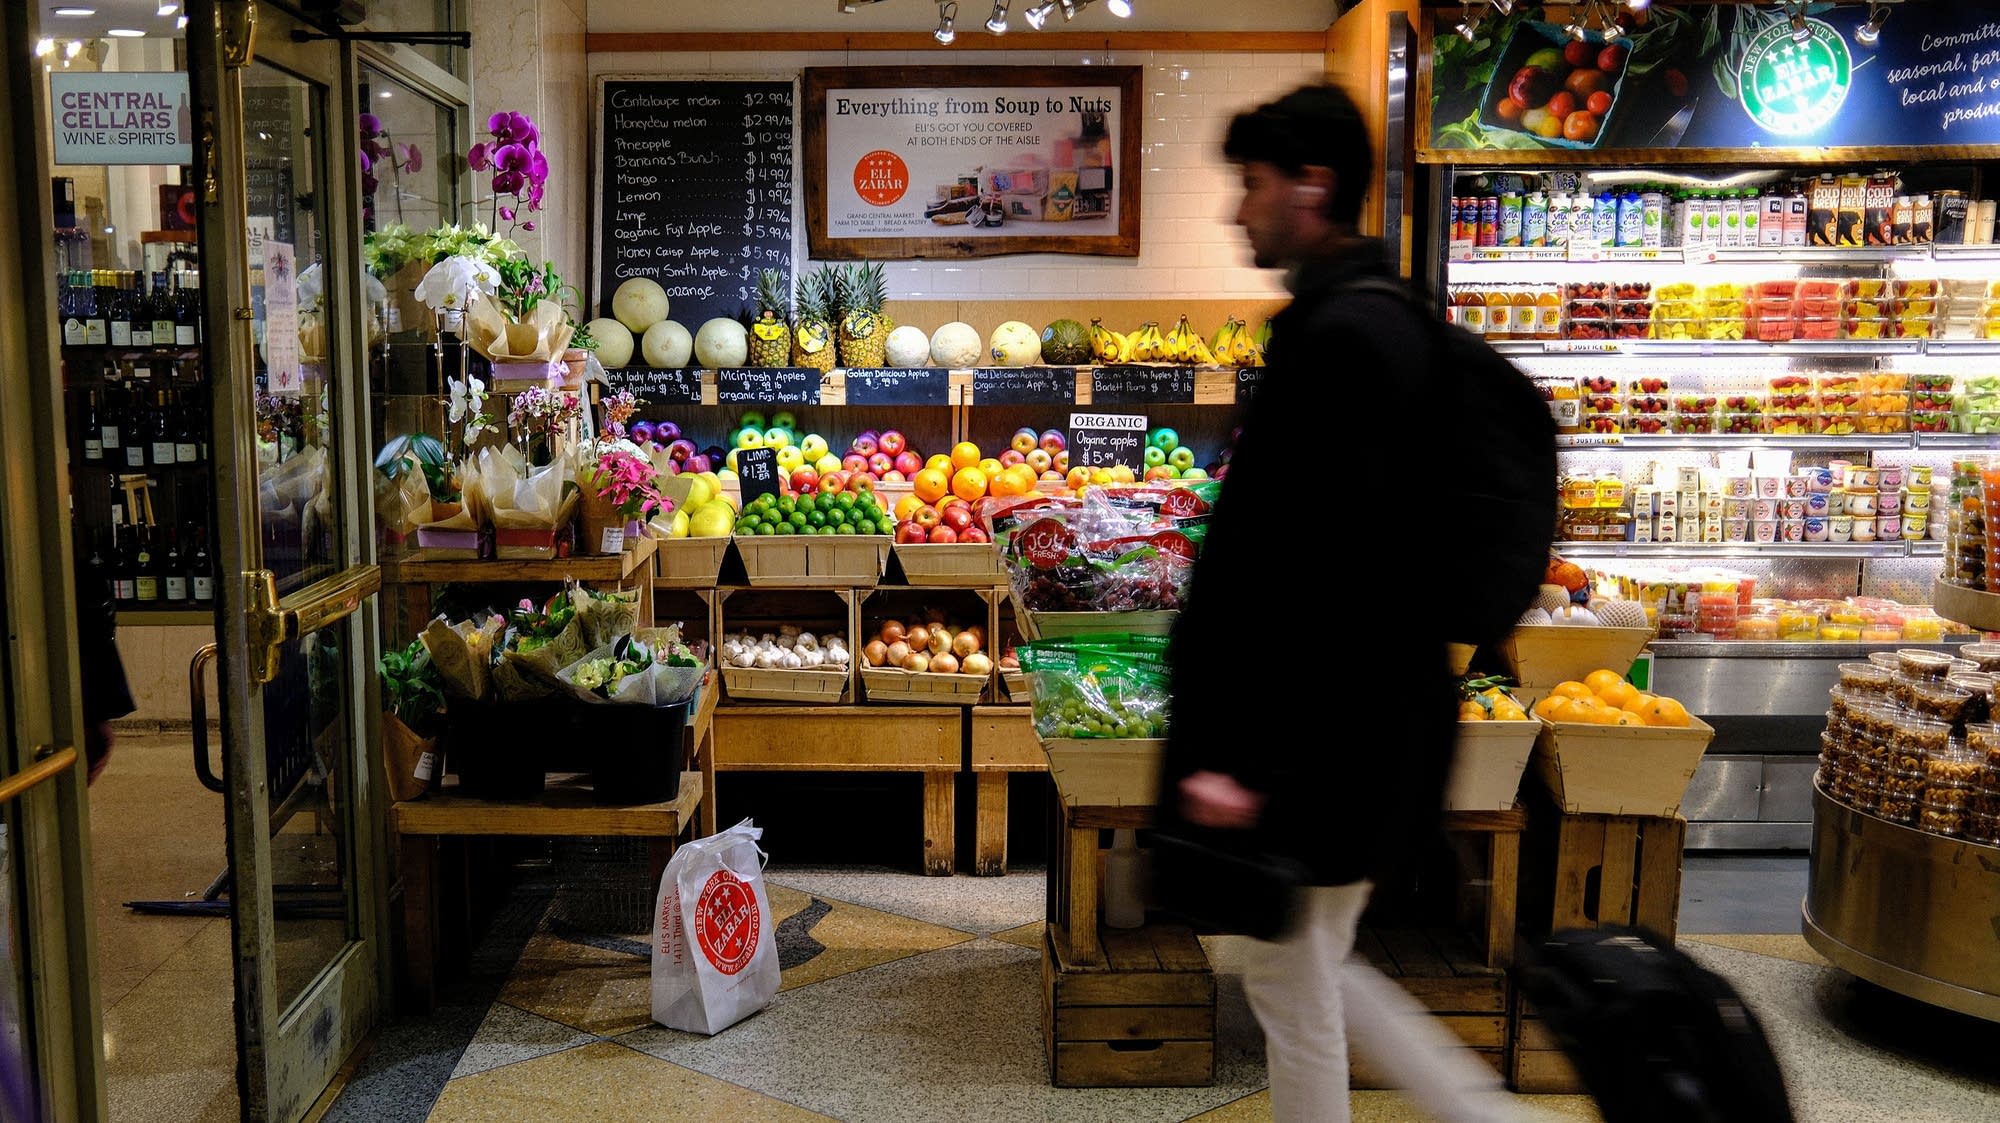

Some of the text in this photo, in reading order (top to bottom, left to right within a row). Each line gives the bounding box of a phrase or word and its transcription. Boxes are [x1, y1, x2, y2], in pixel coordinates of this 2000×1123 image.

[1744, 22, 1835, 73] NEW YOR CITY
[1774, 55, 1809, 80] ELI
[1888, 52, 1967, 83] seasonal,
[1902, 76, 1986, 106] local and
[61, 92, 172, 109] CENTRAL
[612, 90, 680, 109] Cantaloupe
[688, 96, 721, 106] melon
[836, 96, 1111, 117] Everything from Soup to Nuts
[62, 112, 171, 129] CELLARS
[614, 113, 669, 130] Honeydew
[674, 117, 707, 128] melon
[915, 122, 1033, 133] ELI'S GOT YOU COVERED
[64, 132, 106, 145] WINE
[118, 132, 176, 145] SPIRITS
[614, 137, 672, 151] Pineapple
[906, 135, 1040, 146] AT BOTH ENDS OF THE AISLE
[614, 152, 720, 168] Bananas Bunch
[617, 174, 657, 185] Mango
[871, 168, 892, 179] ELI
[860, 179, 902, 190] ZABAR
[618, 190, 661, 203] Lemon
[1814, 188, 1840, 199] COLD
[1841, 188, 1866, 198] COLD
[1867, 188, 1894, 198] COLD
[1813, 199, 1840, 209] BREW
[1842, 198, 1866, 208] BREW
[1867, 198, 1894, 209] BREW
[616, 210, 647, 228] Lime
[614, 228, 660, 242] Organic
[666, 224, 684, 238] Fuji
[688, 222, 723, 238] Apple
[616, 246, 651, 259] Honey
[656, 247, 683, 258] Crisp
[690, 246, 720, 259] Apple
[616, 263, 729, 281] Granny Smith Apple
[605, 370, 622, 381] Pink
[627, 371, 644, 383] lady
[648, 372, 673, 383] Apples
[720, 370, 806, 384] Mcintosh Apples
[847, 368, 930, 379] Golden Delicious Apples
[974, 370, 988, 379] Red
[774, 382, 782, 390] lb
[892, 378, 899, 386] lb
[1184, 382, 1192, 392] lb
[629, 384, 656, 394] Apples
[720, 392, 755, 401] Organic
[758, 392, 774, 402] Fuji
[778, 392, 799, 401] Apple
[1075, 416, 1143, 428] ORGANIC
[1077, 430, 1138, 451] Organic apples
[1170, 496, 1196, 511] JOY
[1028, 532, 1065, 552] JOY
[1033, 550, 1057, 560] FRESH
[696, 874, 720, 935] NEW YORK
[714, 901, 735, 931] ELI
[662, 896, 672, 954] ELI'S MARKET
[673, 916, 682, 940] Third
[714, 904, 749, 954] ZABAR
[674, 944, 682, 965] 1411
